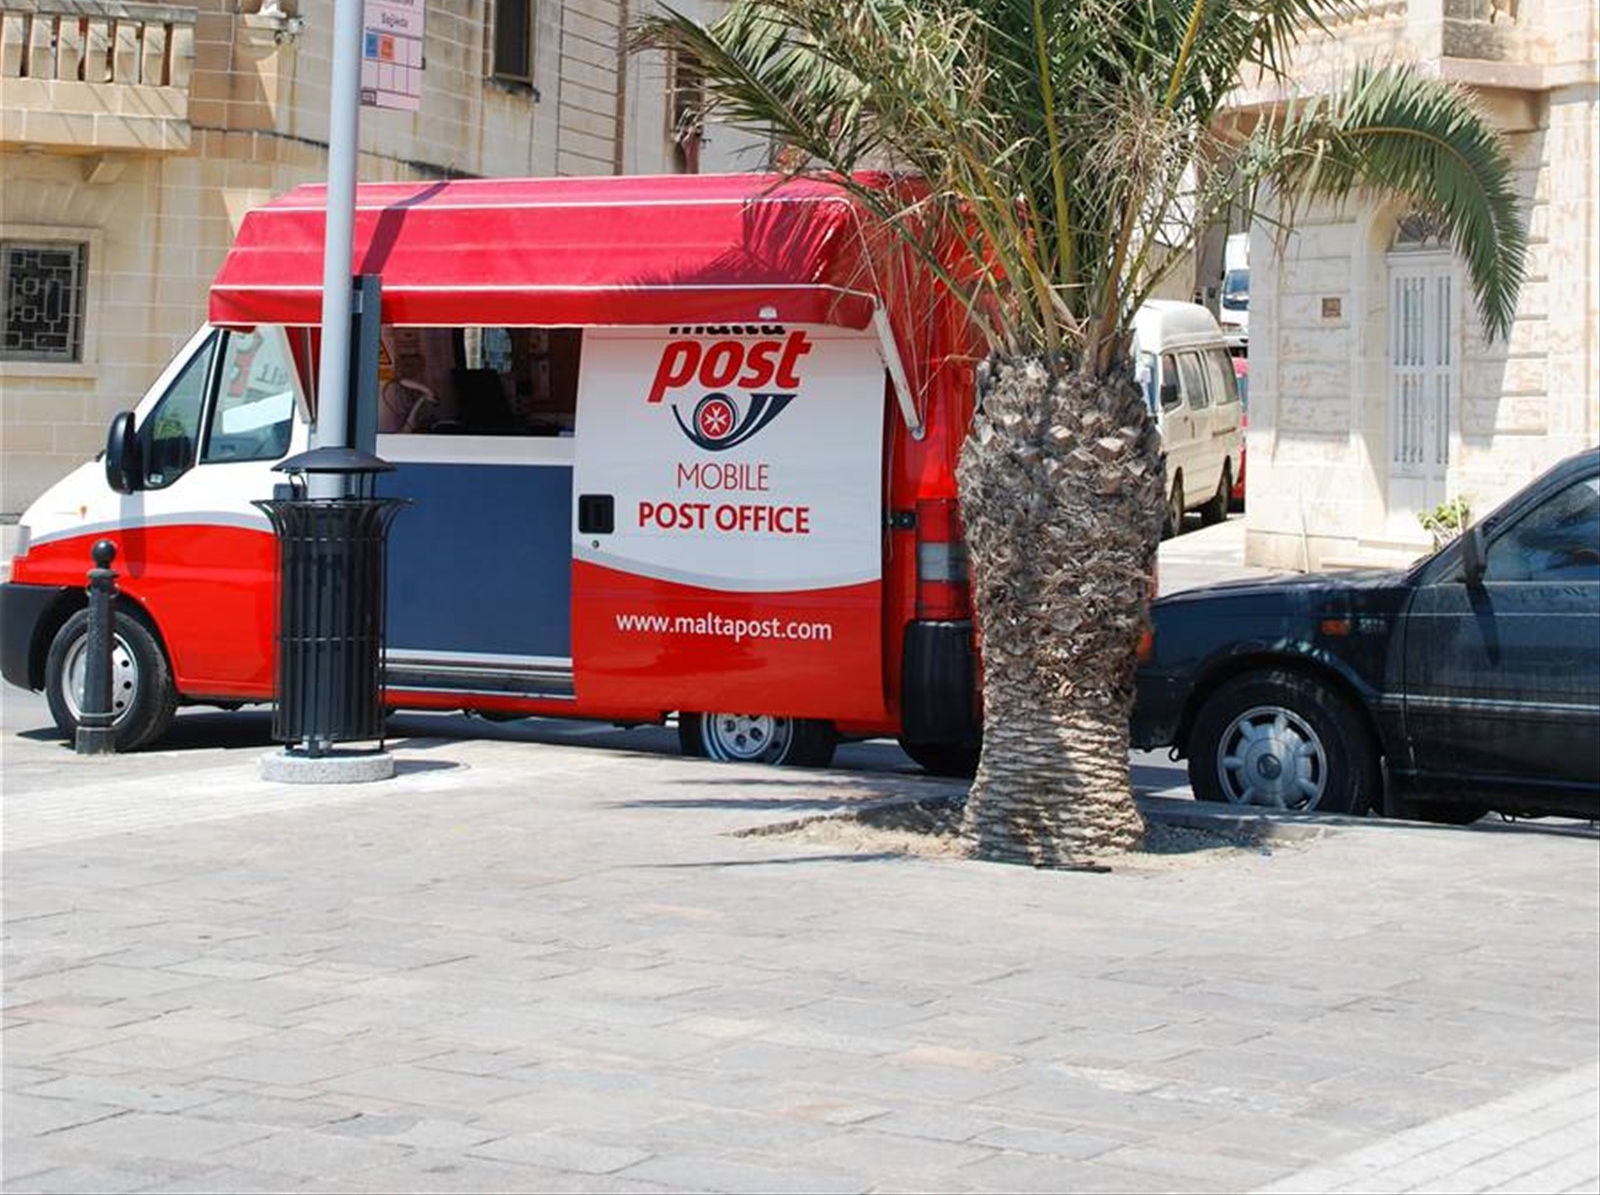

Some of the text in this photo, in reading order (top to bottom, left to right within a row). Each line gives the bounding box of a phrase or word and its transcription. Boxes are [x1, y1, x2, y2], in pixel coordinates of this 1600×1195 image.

[647, 331, 813, 403] post
[676, 463, 770, 491] MOBILE
[638, 502, 810, 534] POST OFFICE
[615, 612, 833, 642] www.maltapost.com
